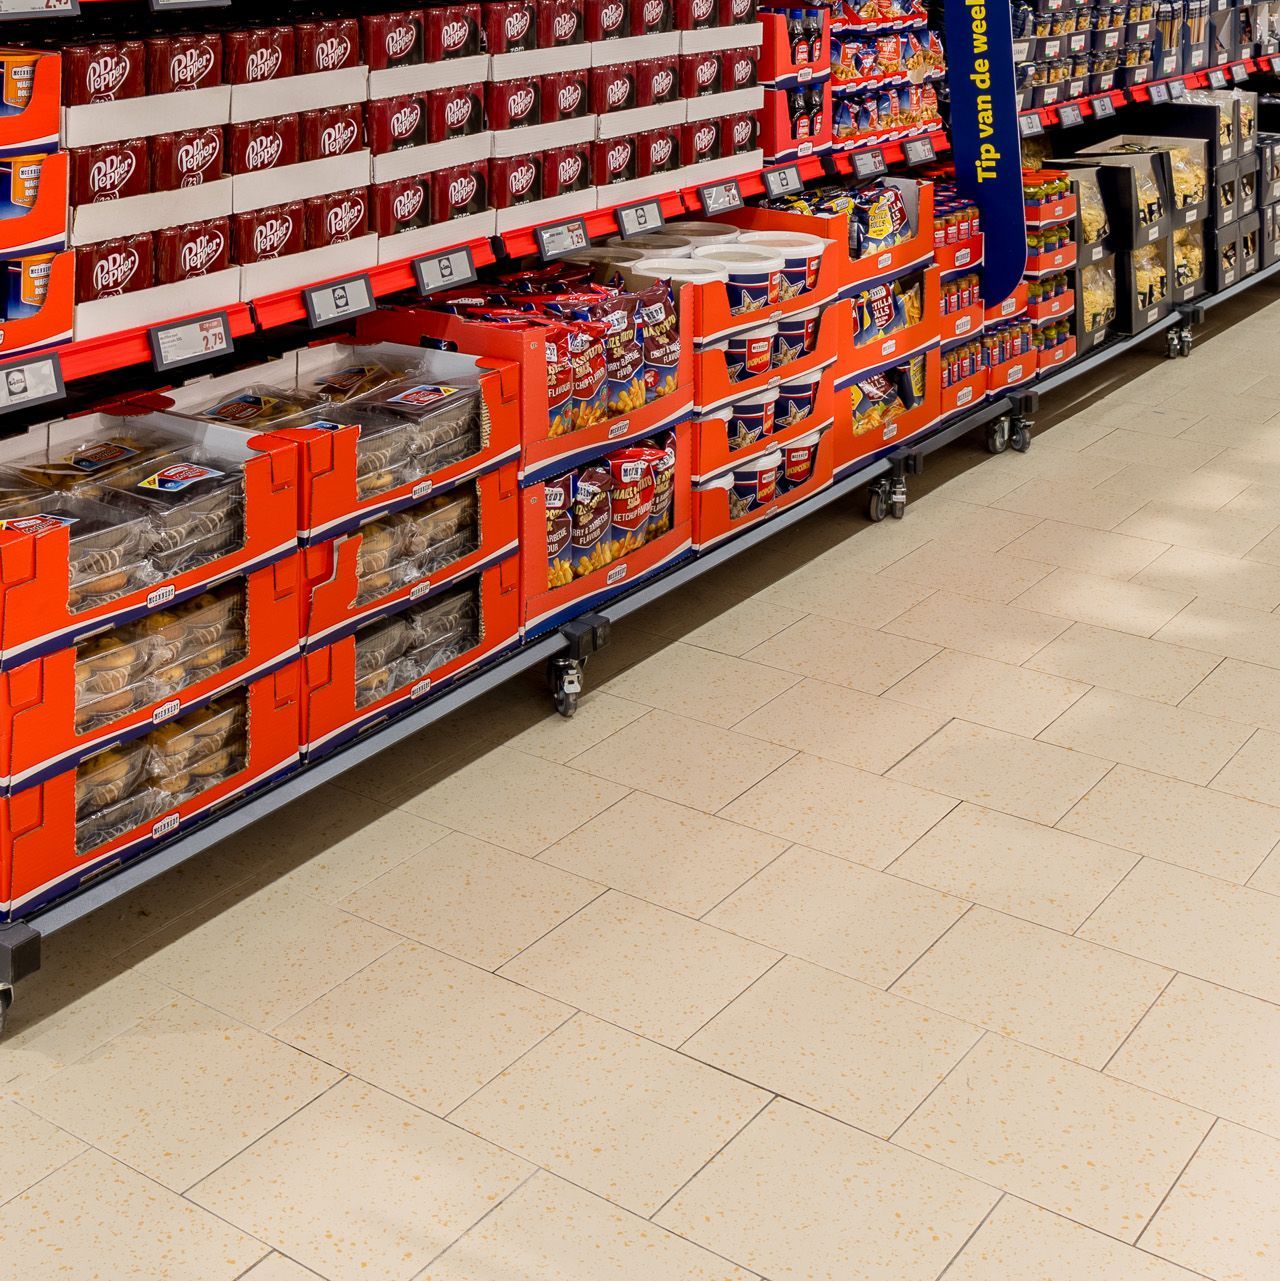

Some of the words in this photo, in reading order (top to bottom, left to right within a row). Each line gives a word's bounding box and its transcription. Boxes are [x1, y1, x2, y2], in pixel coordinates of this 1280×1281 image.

[449, 21, 461, 34] Dr
[327, 38, 340, 52] Dr
[443, 23, 467, 51] Pepper
[186, 49, 199, 65] Dr
[257, 48, 271, 64] Dr
[316, 41, 346, 69] Pepper
[99, 56, 117, 73] Dr
[173, 54, 210, 83] Pepper
[248, 53, 278, 81] Pepper
[970, 59, 990, 88] de
[89, 61, 125, 94] Pepper
[977, 95, 993, 139] van
[192, 138, 204, 155] Dr
[105, 155, 121, 172] Dr
[182, 141, 216, 173] Pepper
[977, 146, 1000, 183] Tip
[94, 158, 131, 192] Pepper
[202, 332, 224, 352] 2.79
[613, 508, 637, 522] KETCHUP
[580, 528, 601, 545] FLAVOUR
[149, 589, 174, 605] MCENNEDY
[155, 702, 179, 720] MCENNEDY
[154, 817, 179, 835] MCENNEDY
